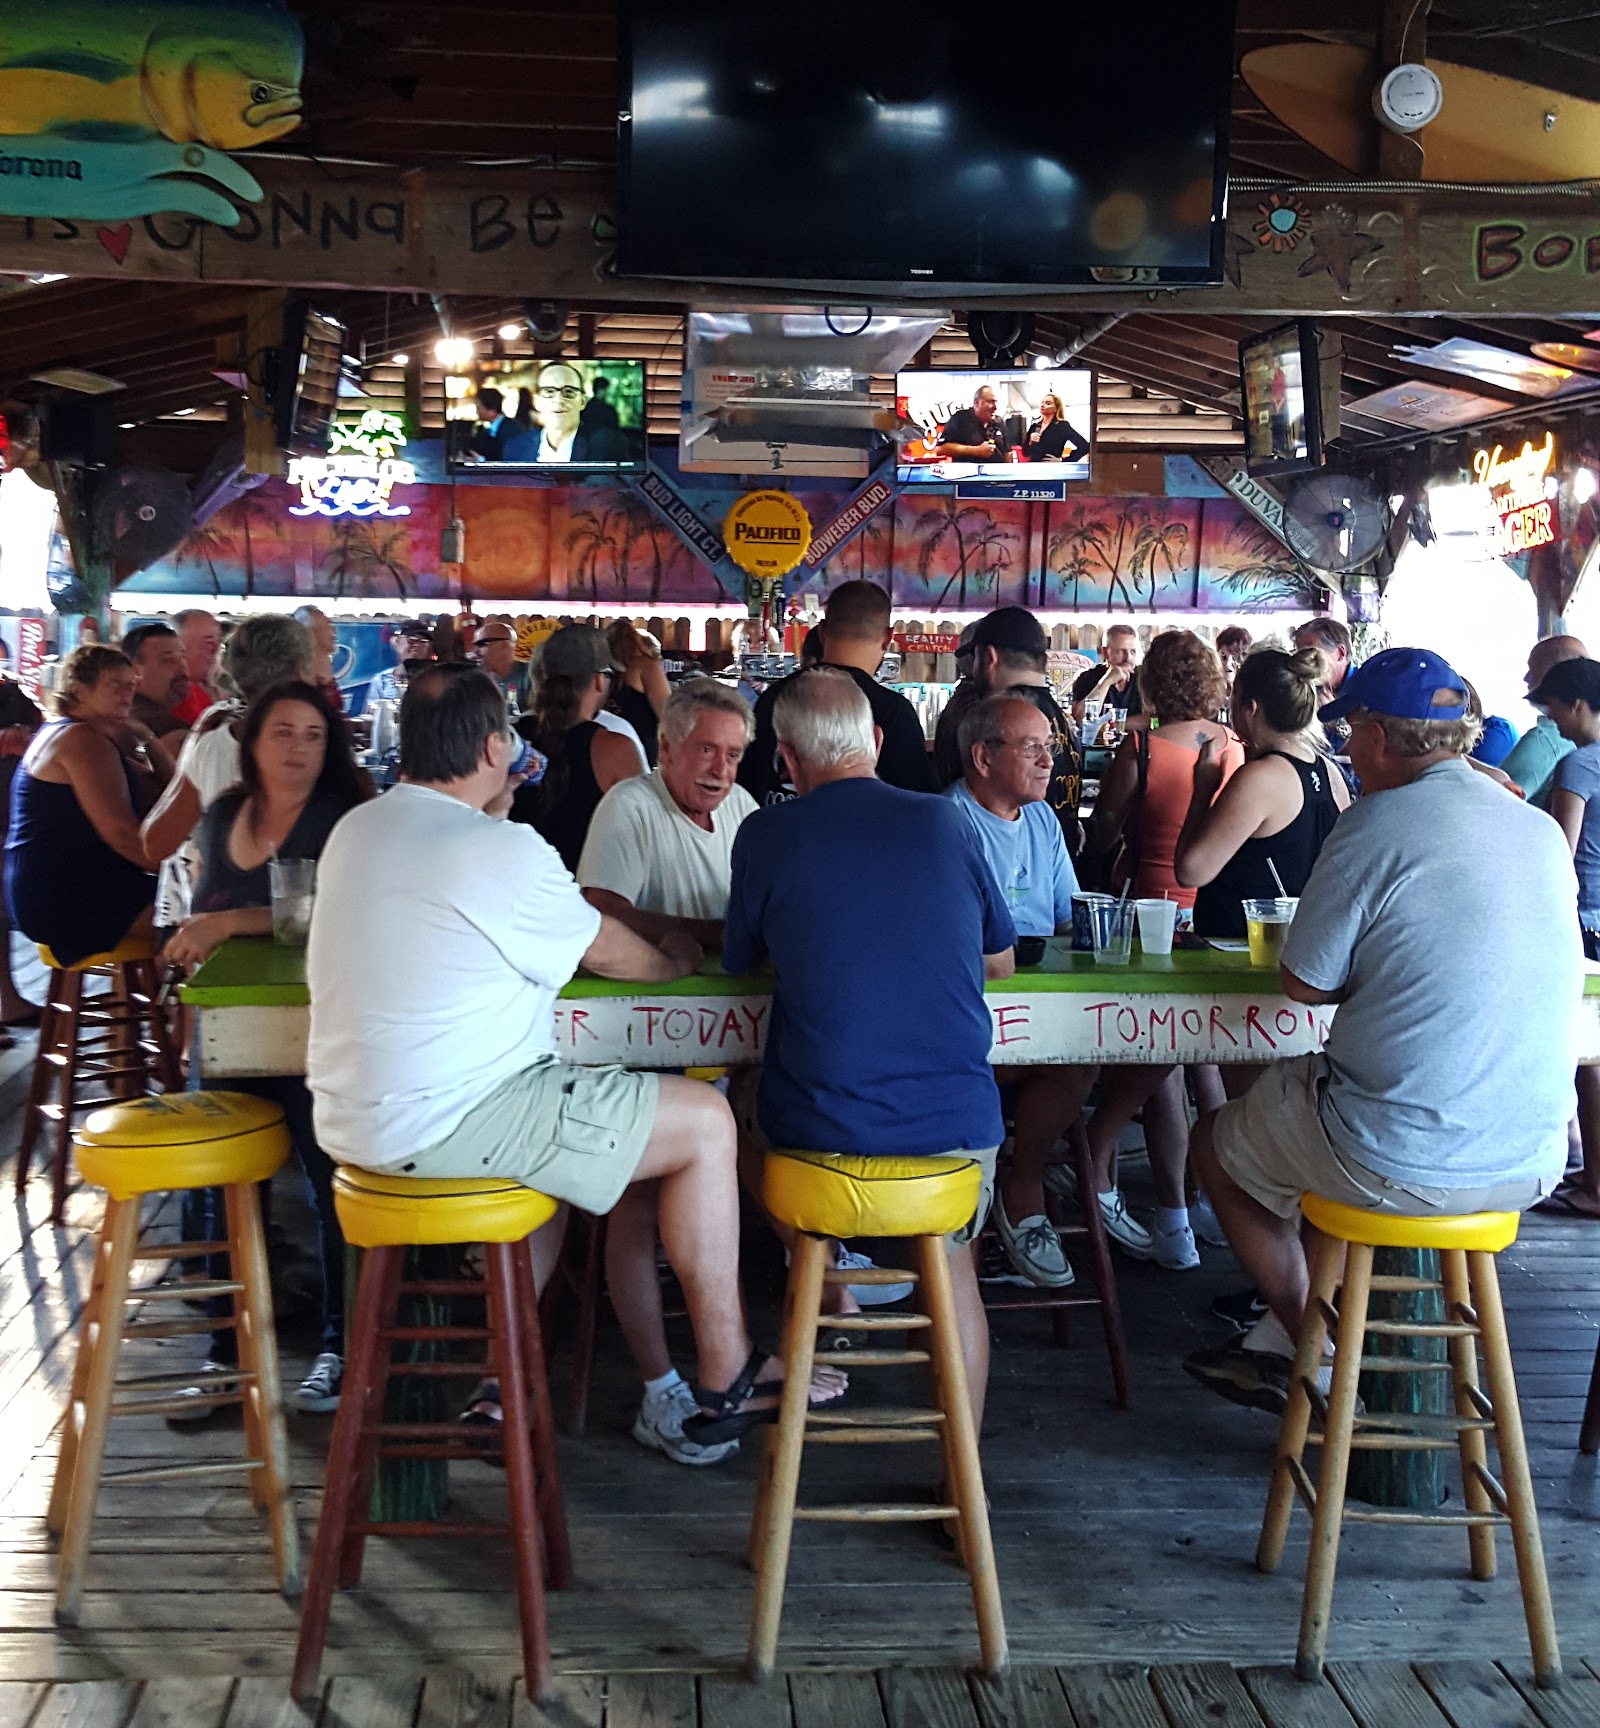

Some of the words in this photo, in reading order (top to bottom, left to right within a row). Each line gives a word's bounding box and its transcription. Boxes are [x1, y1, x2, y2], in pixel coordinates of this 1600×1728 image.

[0, 156, 83, 182] orona
[644, 477, 669, 503] BUD
[669, 501, 704, 538] LIGHT
[805, 507, 863, 565] BUDWEISER
[857, 485, 891, 516] BLVD.
[1238, 478, 1285, 531] DUVA
[734, 522, 801, 540] PACIFICO
[632, 1005, 767, 1050] TODAY
